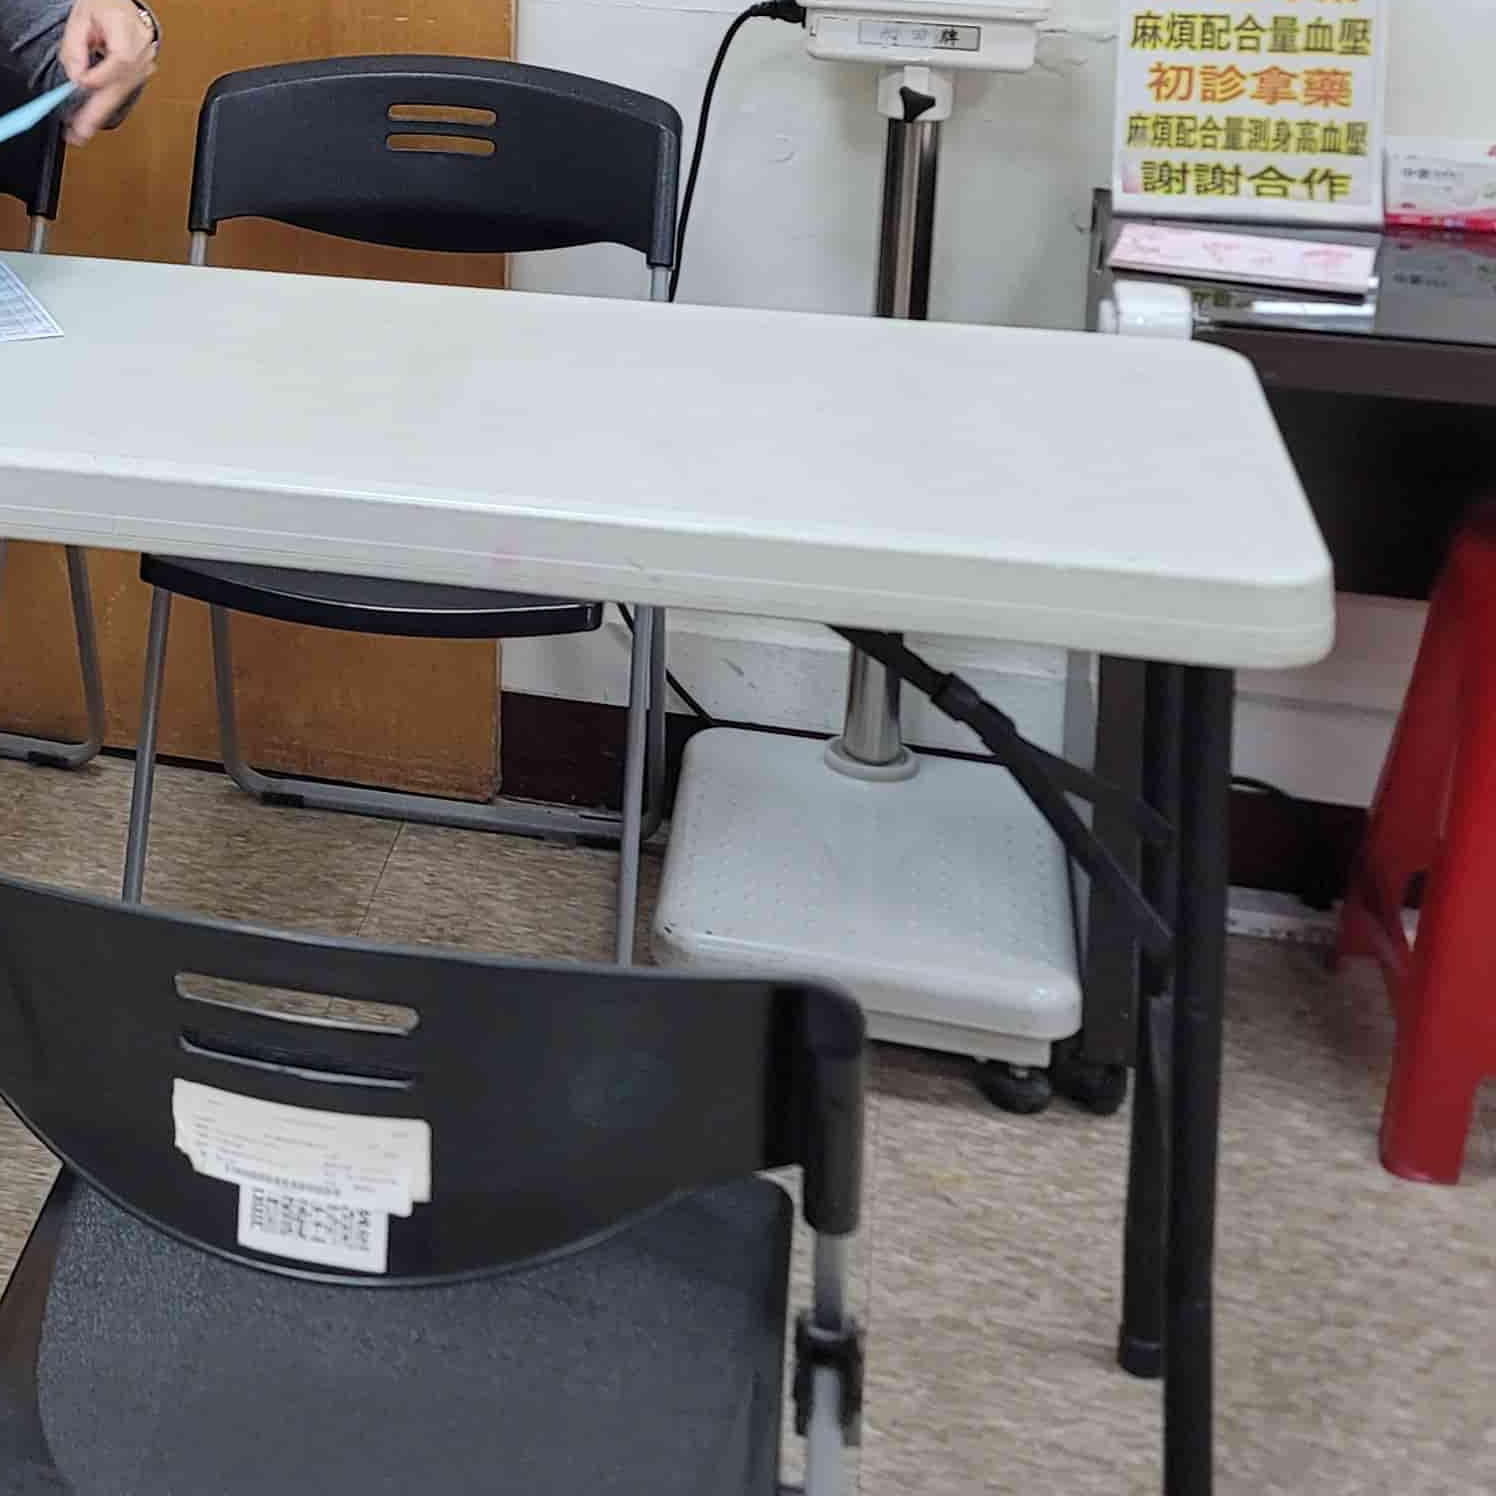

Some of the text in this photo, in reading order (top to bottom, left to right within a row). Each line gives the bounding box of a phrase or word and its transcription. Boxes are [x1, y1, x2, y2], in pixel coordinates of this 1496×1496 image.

[1129, 12, 1373, 57] 麻煩配合量血壓
[1147, 62, 1354, 108] 初診拿藥
[1140, 160, 1353, 202] 謝謝合作
